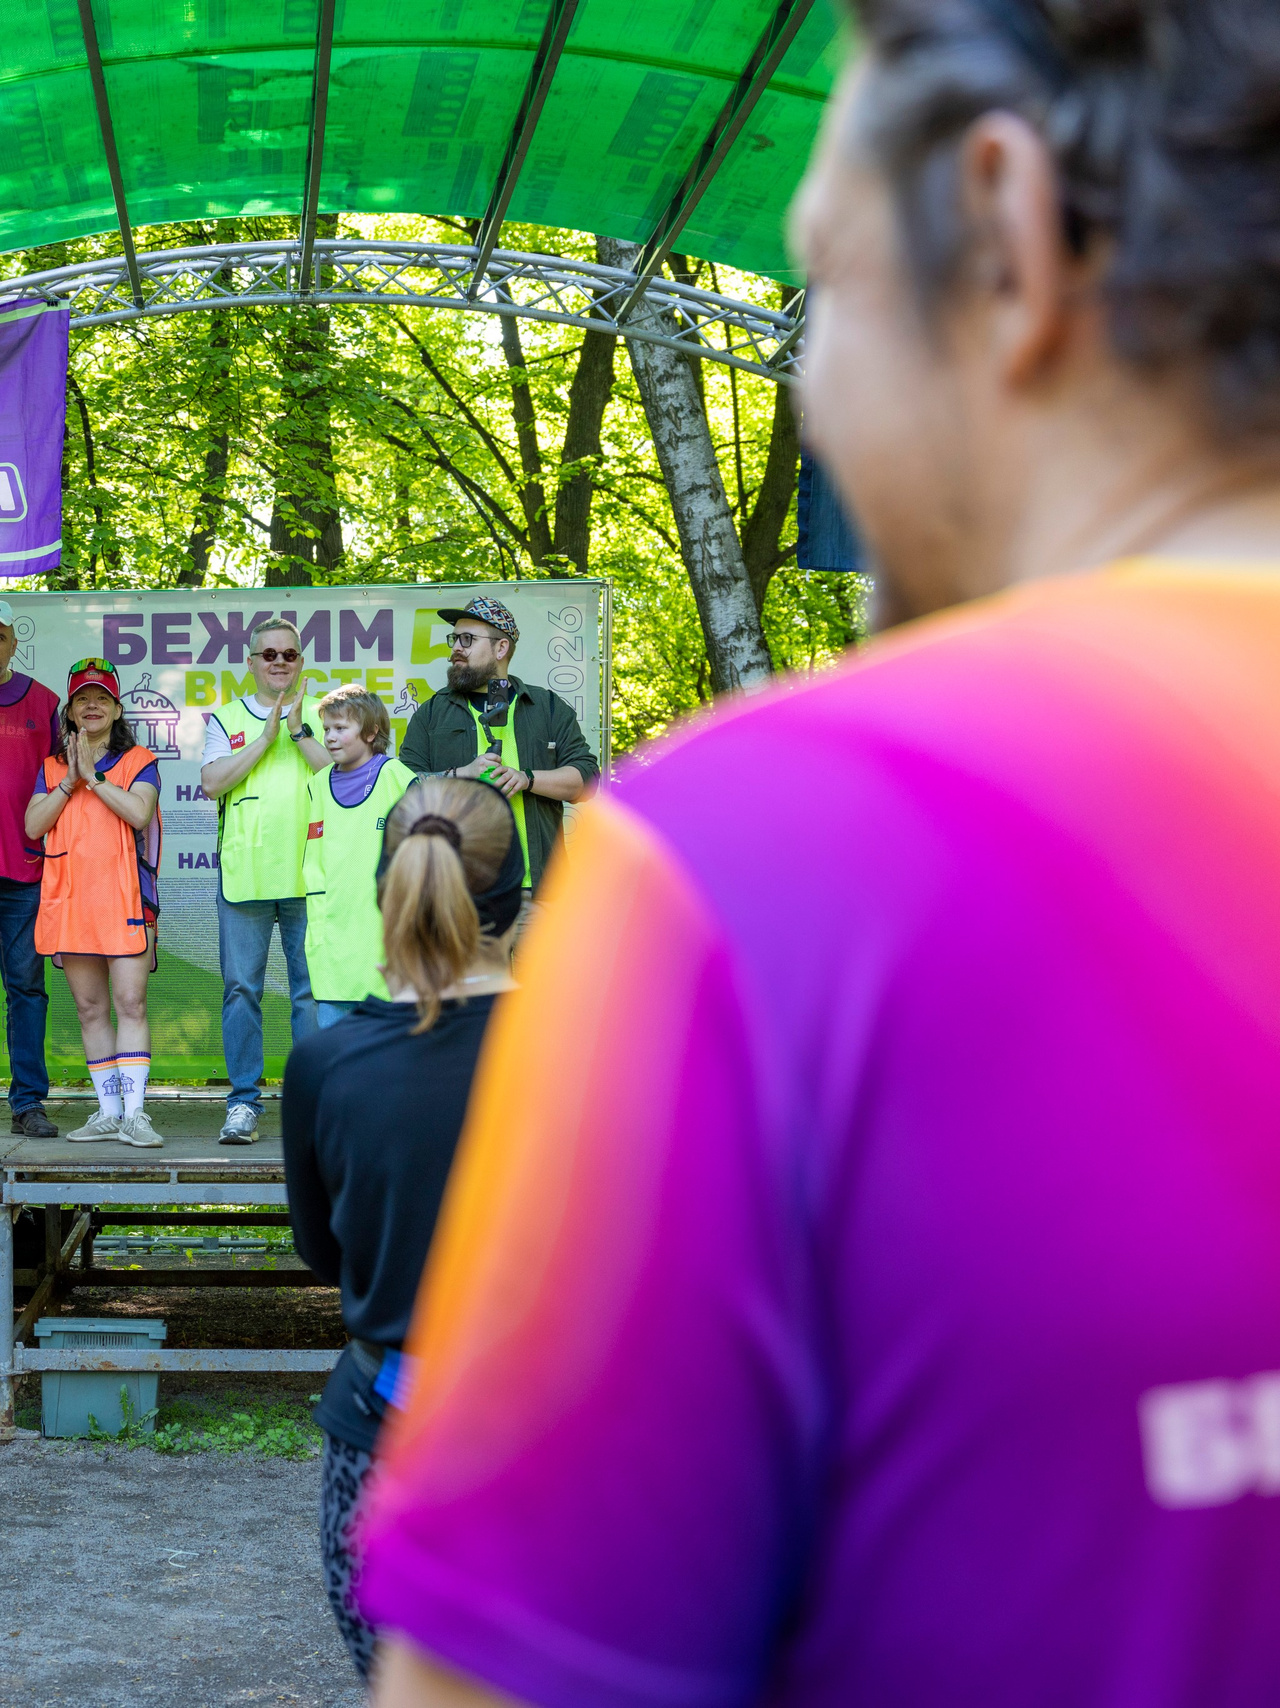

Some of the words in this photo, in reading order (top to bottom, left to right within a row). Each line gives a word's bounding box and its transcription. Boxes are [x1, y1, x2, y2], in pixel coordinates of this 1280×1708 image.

[102, 608, 394, 665] БЕЖИМ
[184, 668, 395, 707] ВМСТЕ
[176, 784, 217, 802] НА
